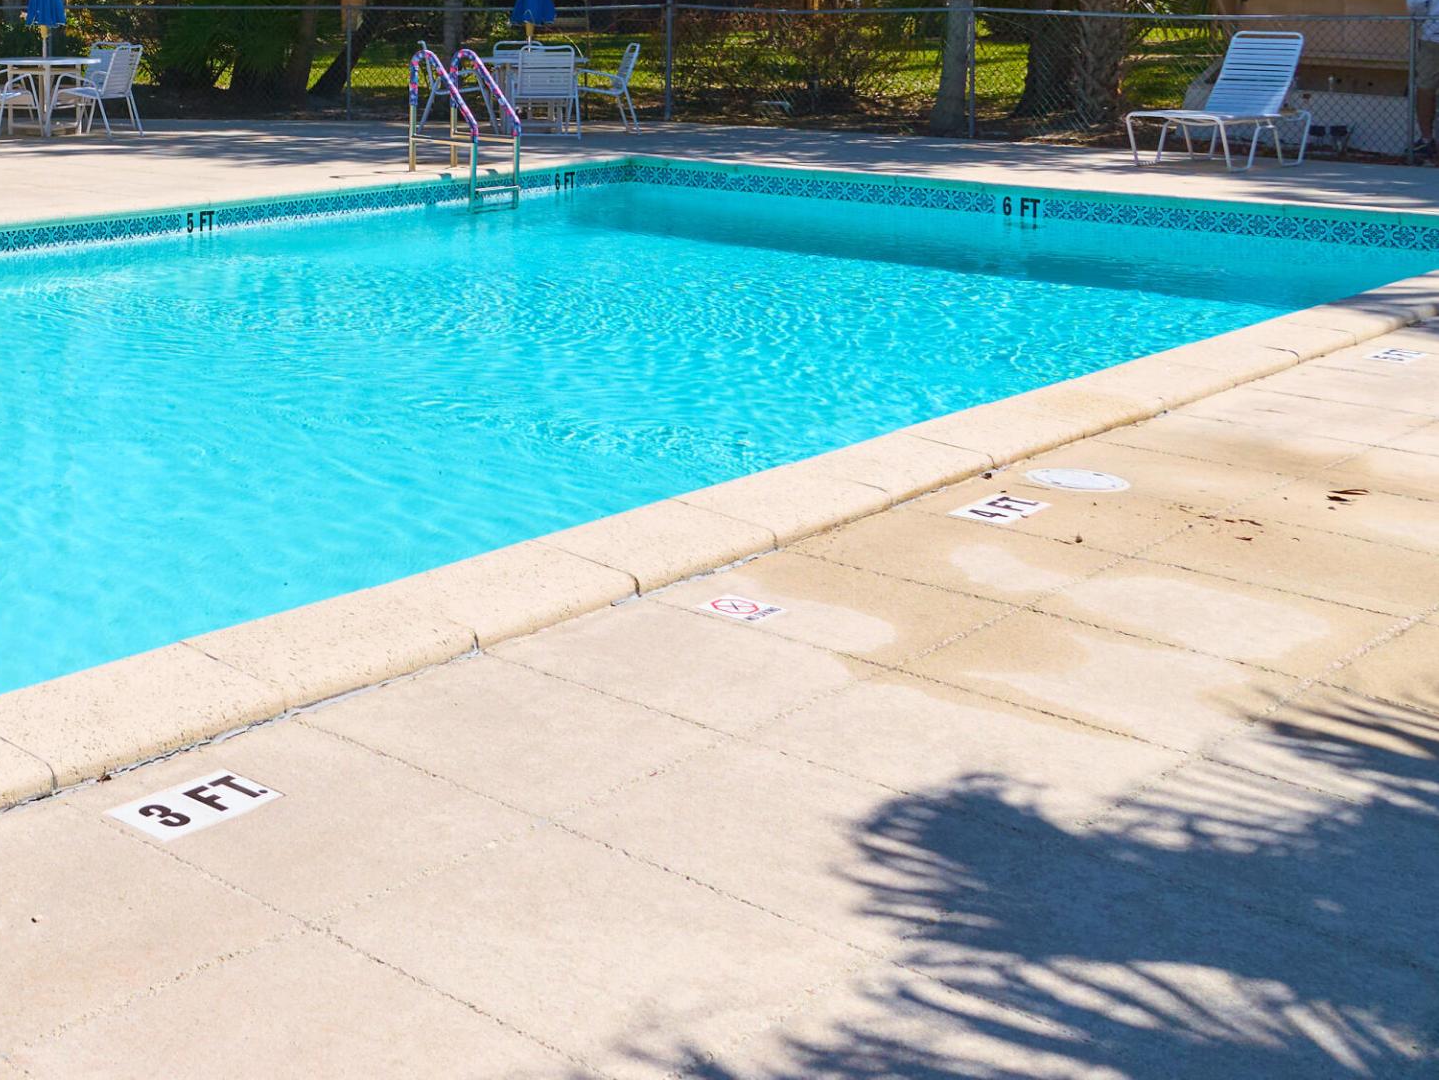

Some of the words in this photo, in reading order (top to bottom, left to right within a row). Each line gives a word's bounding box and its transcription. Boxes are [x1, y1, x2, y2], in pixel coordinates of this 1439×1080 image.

[555, 173, 560, 190] 6
[564, 172, 575, 189] FT
[1003, 196, 1011, 215] 6
[1021, 197, 1040, 217] FT
[187, 213, 193, 233] 5
[200, 211, 214, 231] FT
[969, 509, 1008, 518] 4
[138, 804, 191, 827] 3
[182, 775, 268, 812] FT.
